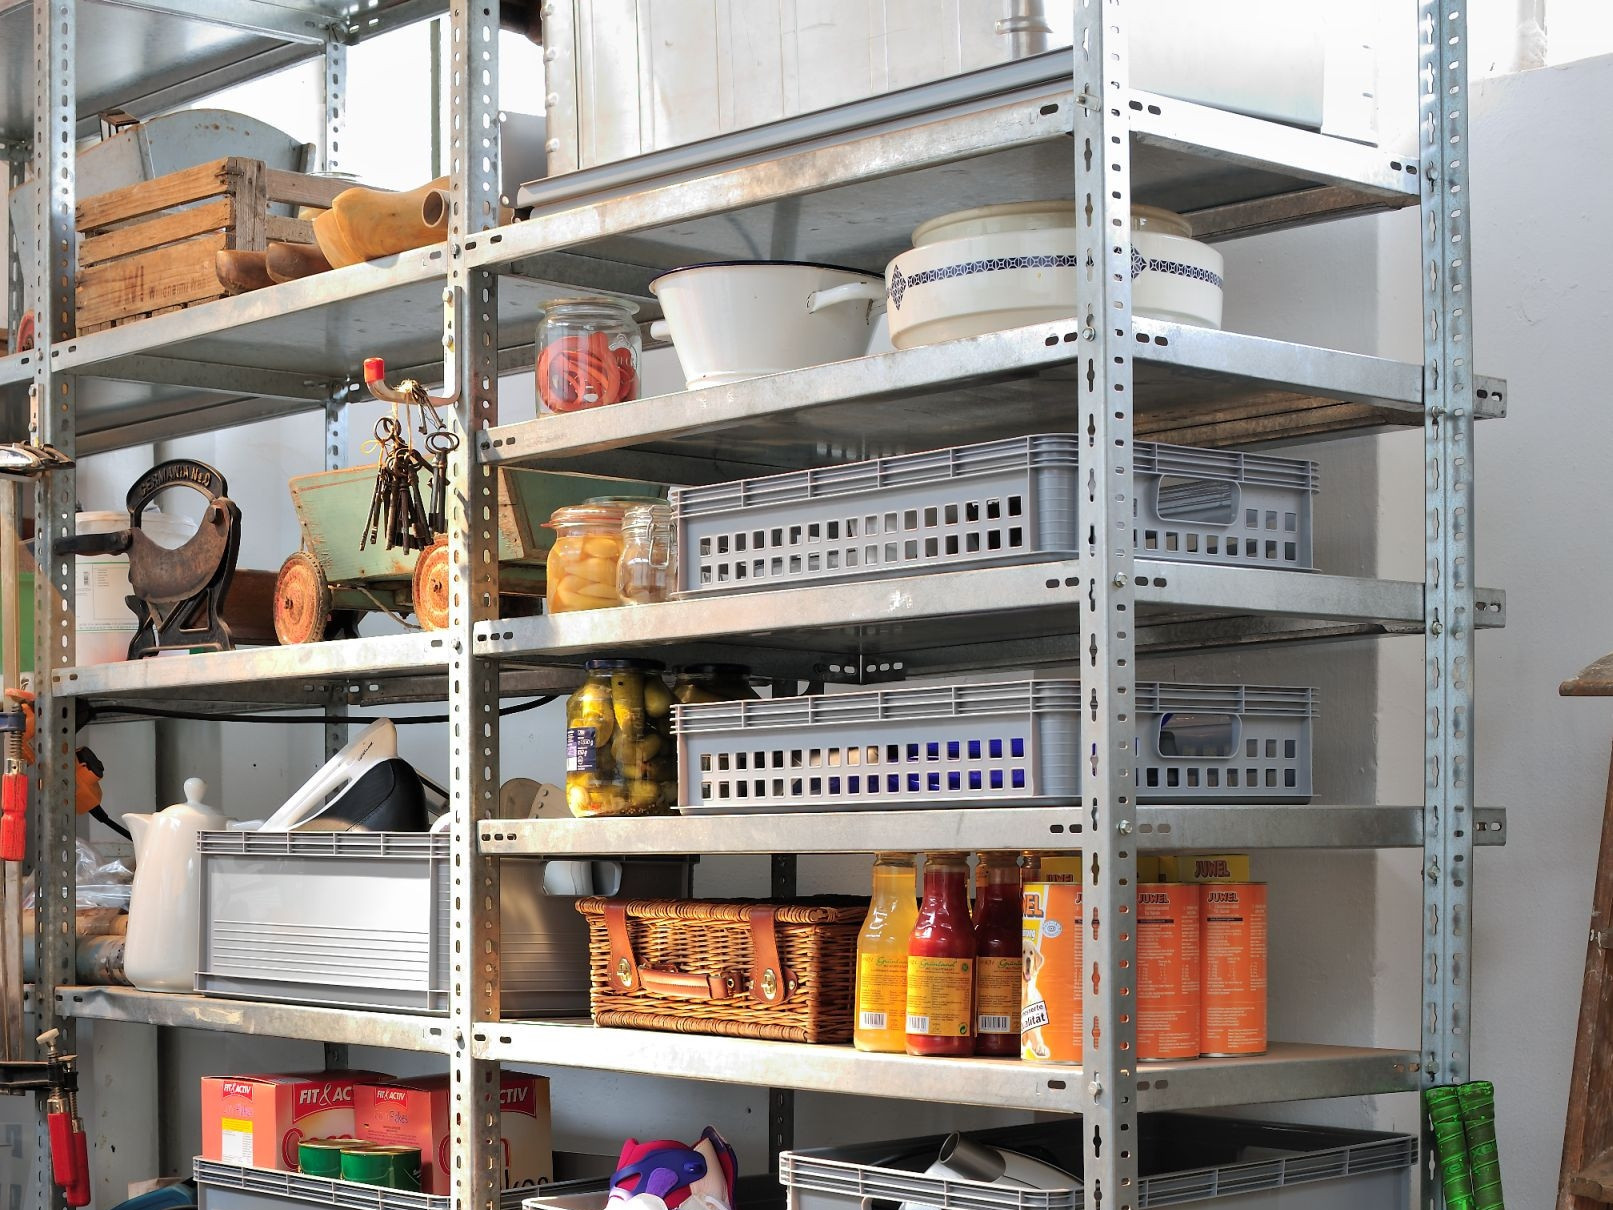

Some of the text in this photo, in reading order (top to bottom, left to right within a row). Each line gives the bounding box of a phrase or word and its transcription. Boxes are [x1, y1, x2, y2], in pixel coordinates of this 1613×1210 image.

[1194, 860, 1231, 878] JUWEL
[1136, 893, 1170, 904] JUWEL
[1207, 891, 1239, 903] JUWEL
[499, 1086, 528, 1104] CTIV
